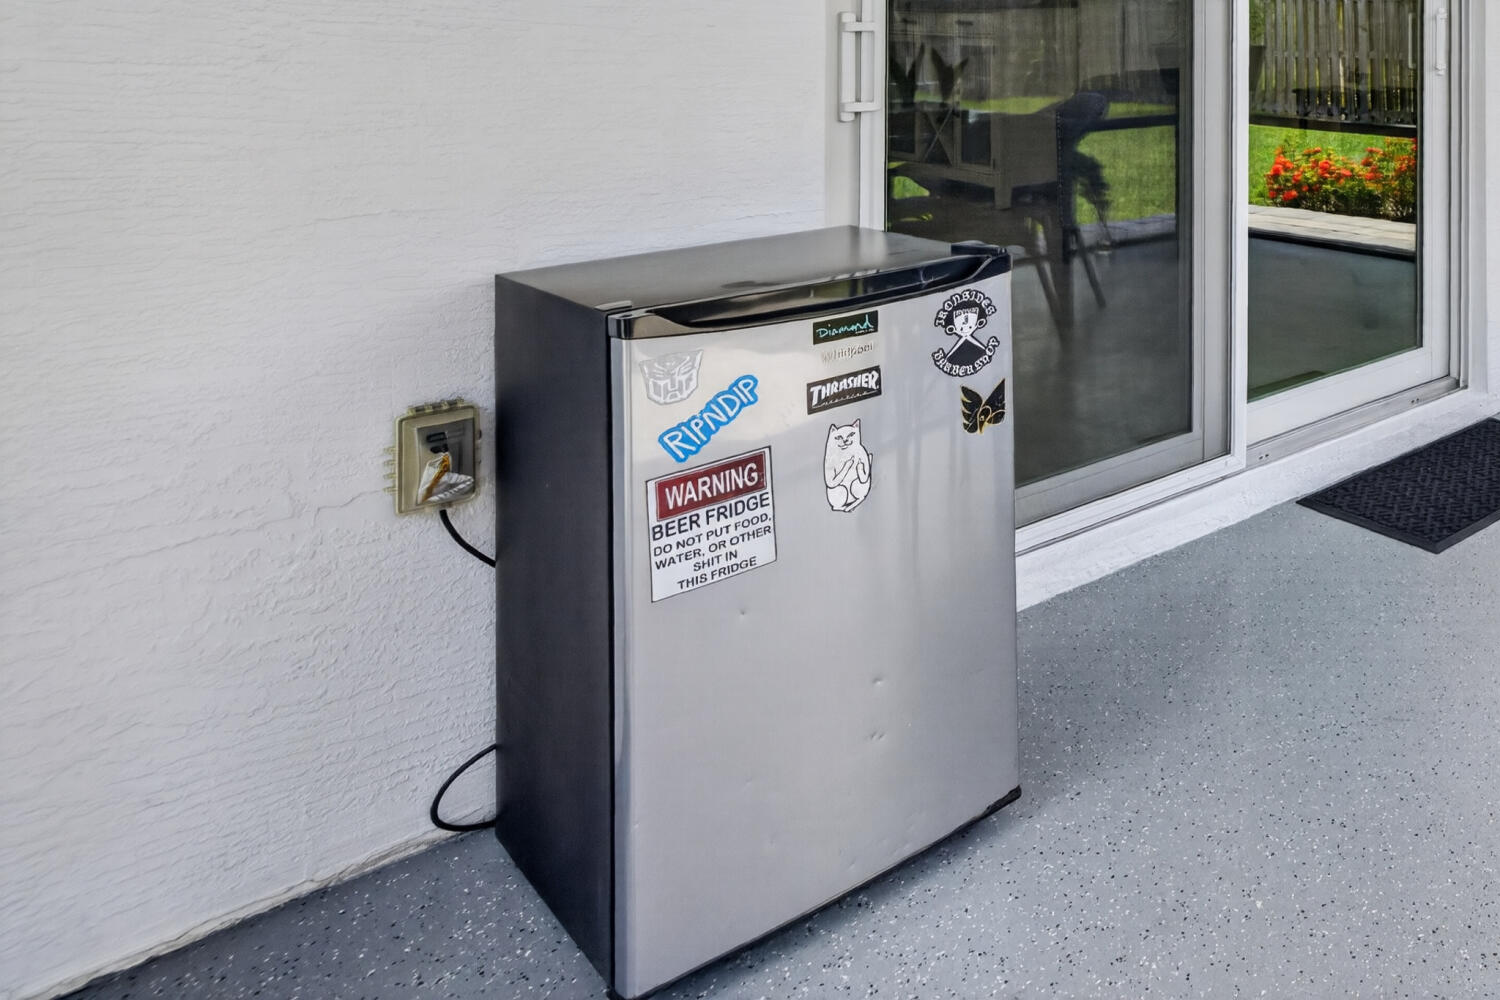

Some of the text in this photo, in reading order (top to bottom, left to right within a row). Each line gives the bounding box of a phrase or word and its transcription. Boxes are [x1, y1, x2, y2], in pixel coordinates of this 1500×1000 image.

[816, 314, 874, 337] Diamond
[810, 370, 879, 406] THRASHER
[663, 379, 754, 459] RIPNDIP
[665, 462, 758, 510] WARNING
[652, 492, 770, 541] BEER FRIDGE
[654, 544, 673, 557] DO
[676, 533, 703, 549] NOT
[706, 525, 731, 541] PUT
[655, 525, 772, 570] WATER, OR OTHER
[677, 556, 757, 589] THIS FRIDGE
[693, 550, 738, 572] SHIT IN
